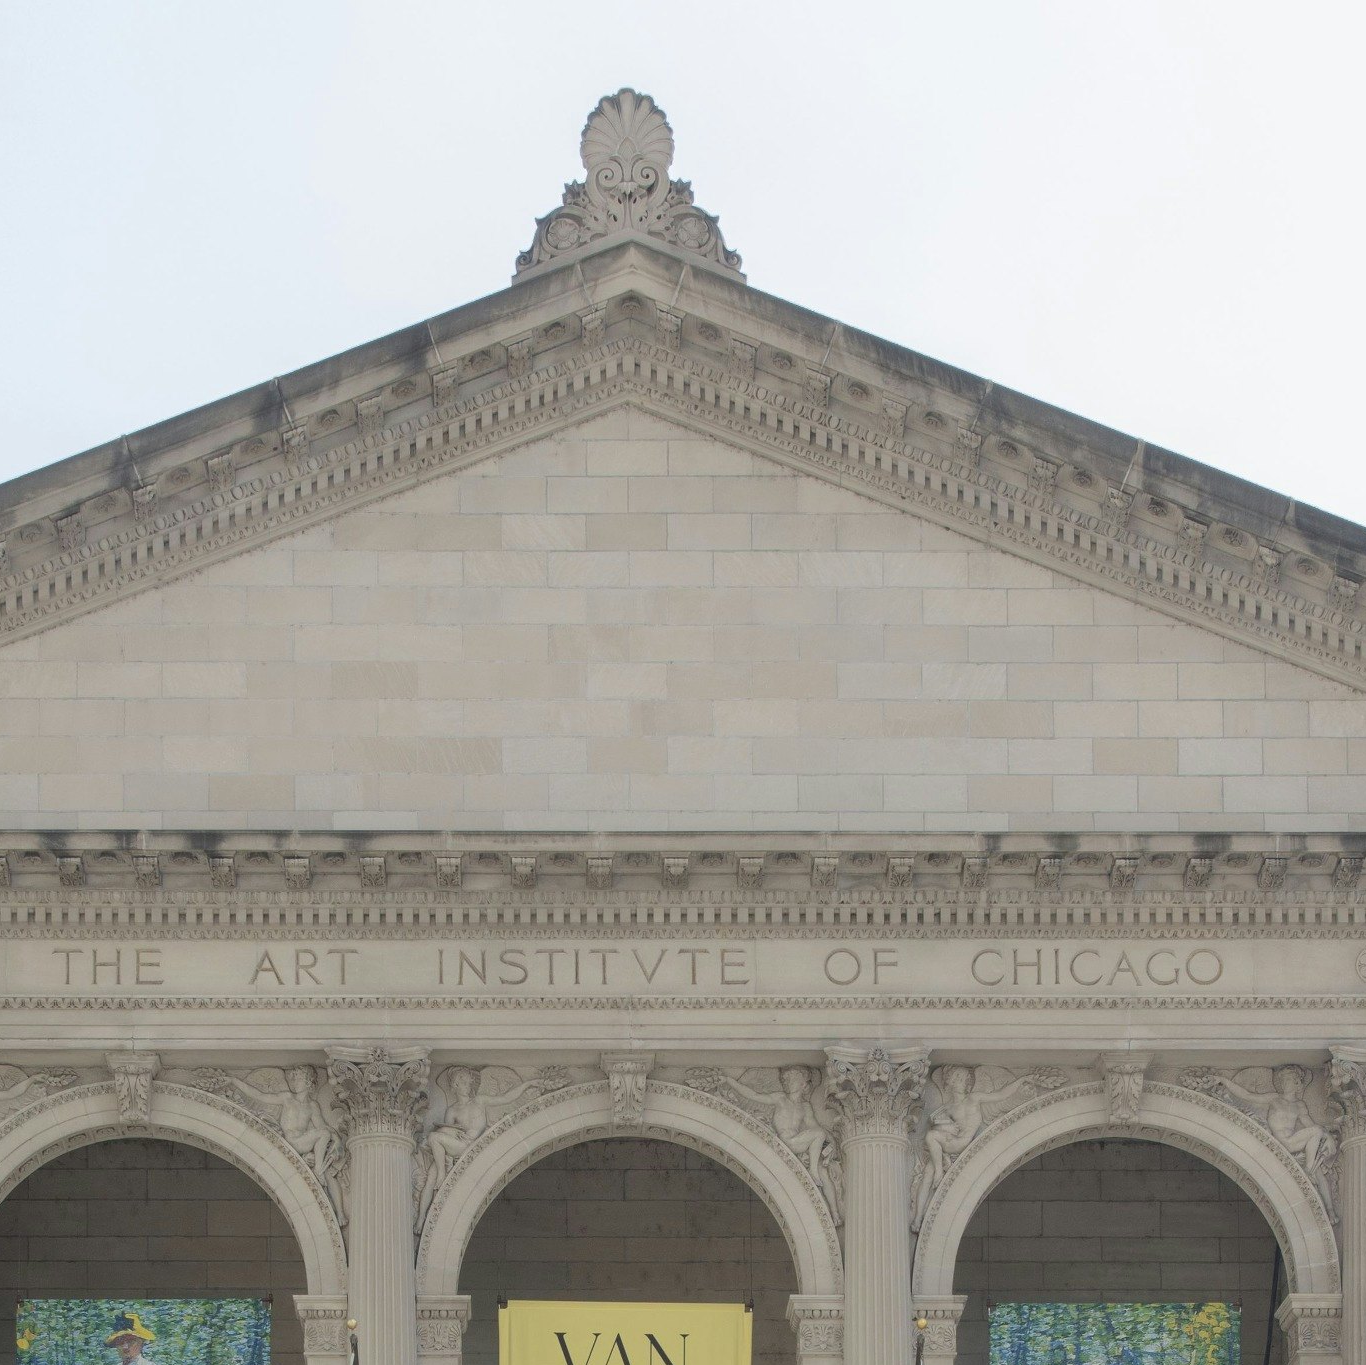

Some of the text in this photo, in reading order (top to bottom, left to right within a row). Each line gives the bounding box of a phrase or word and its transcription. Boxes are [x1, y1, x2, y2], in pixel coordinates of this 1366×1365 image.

[51, 947, 1225, 986] THE ART INSTITVTE OF CHICAGO
